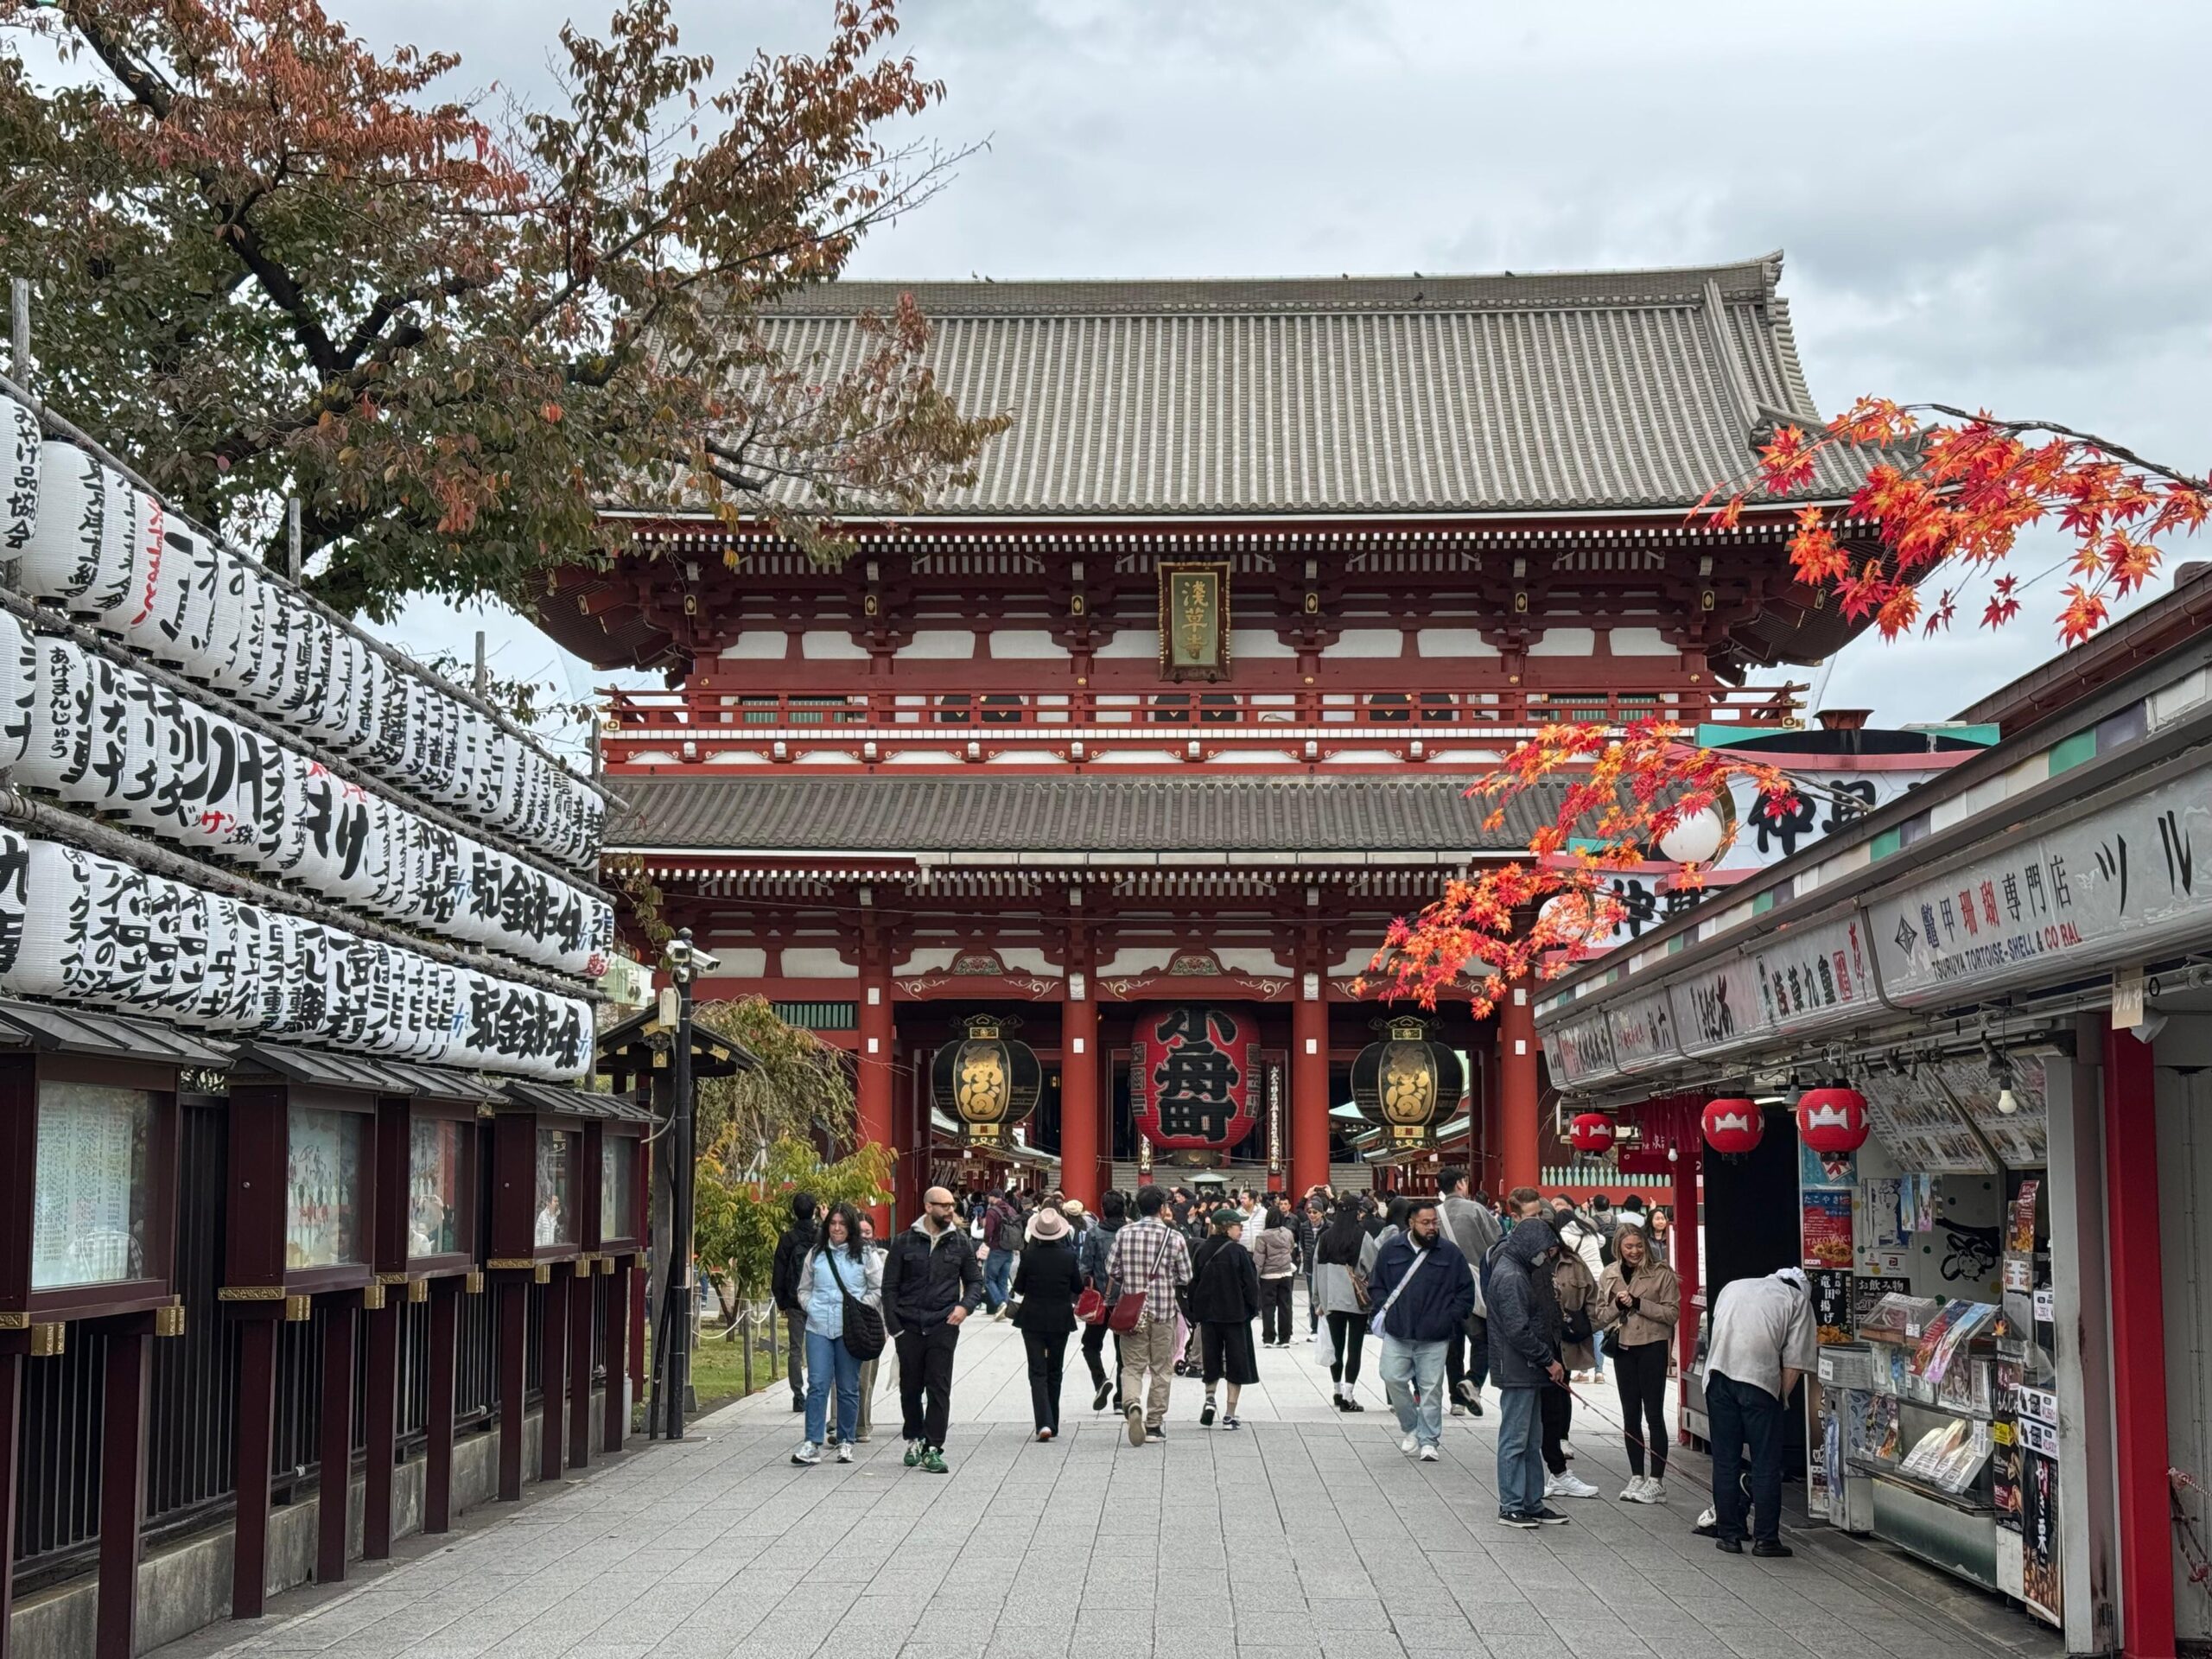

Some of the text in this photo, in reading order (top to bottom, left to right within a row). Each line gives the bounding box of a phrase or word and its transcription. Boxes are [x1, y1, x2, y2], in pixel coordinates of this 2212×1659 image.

[49, 645, 77, 760] あげまんじゅう
[1932, 952, 1967, 980] TSURUYA
[2036, 931, 2044, 951] &
[1805, 1234, 1851, 1246] TAKOYAKI
[1820, 1274, 1835, 1325] 竜田揚げ
[1858, 1279, 1904, 1292] お飲み物
